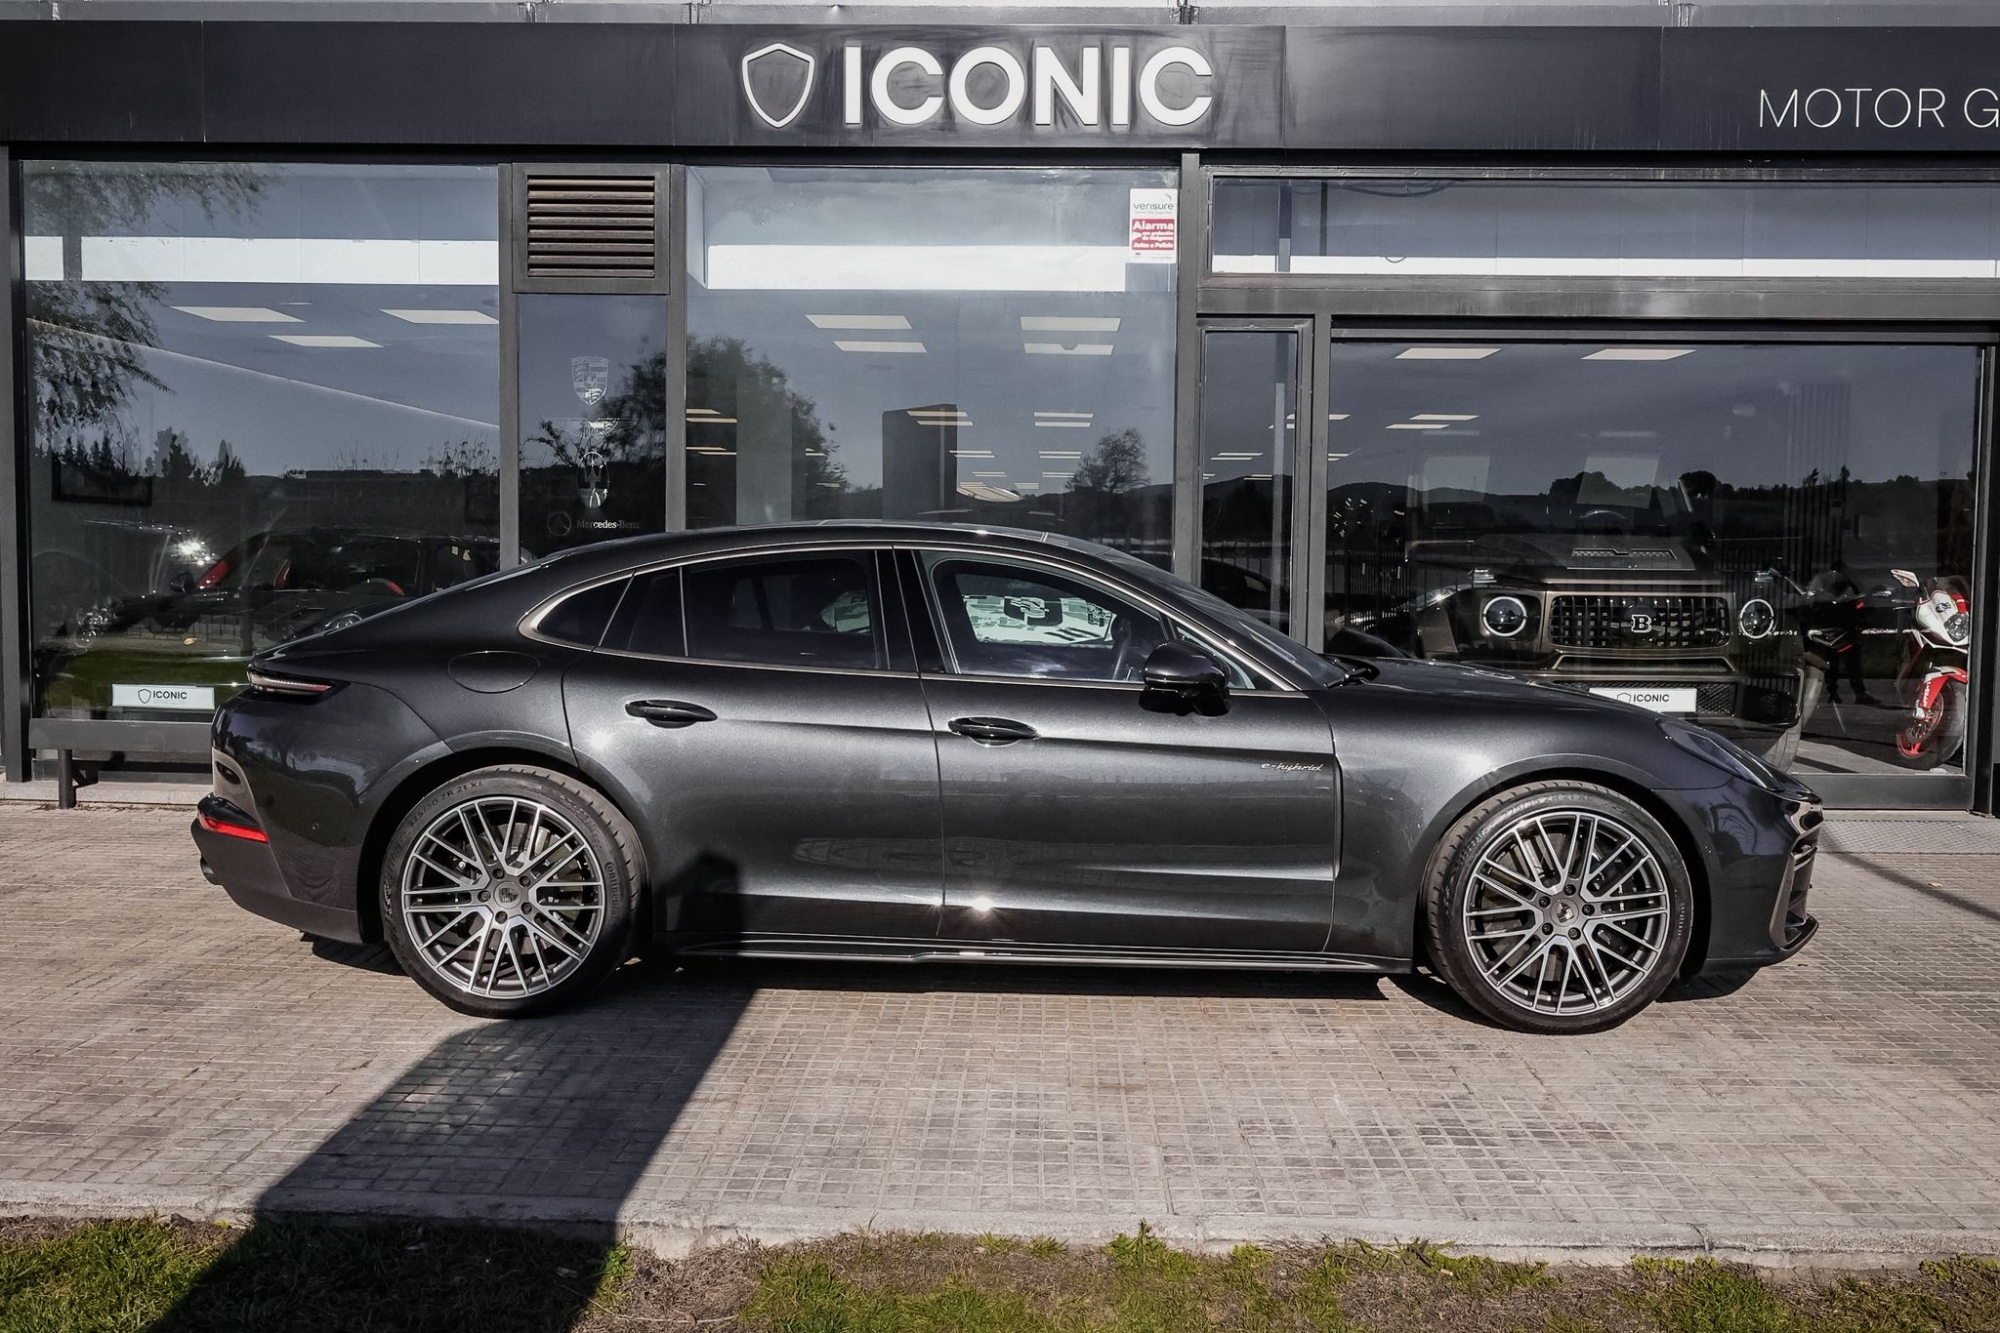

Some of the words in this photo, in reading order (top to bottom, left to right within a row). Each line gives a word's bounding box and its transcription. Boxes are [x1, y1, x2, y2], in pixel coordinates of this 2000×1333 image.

[845, 46, 1212, 126] ICONIC
[1759, 88, 1946, 128] MOTOR
[1963, 88, 2000, 128] G
[1132, 220, 1174, 230] Alarma
[577, 519, 640, 529] Mercedes-Benz
[1631, 614, 1651, 633] B
[153, 691, 187, 699] ICONIC
[1633, 694, 1670, 703] ICONIC
